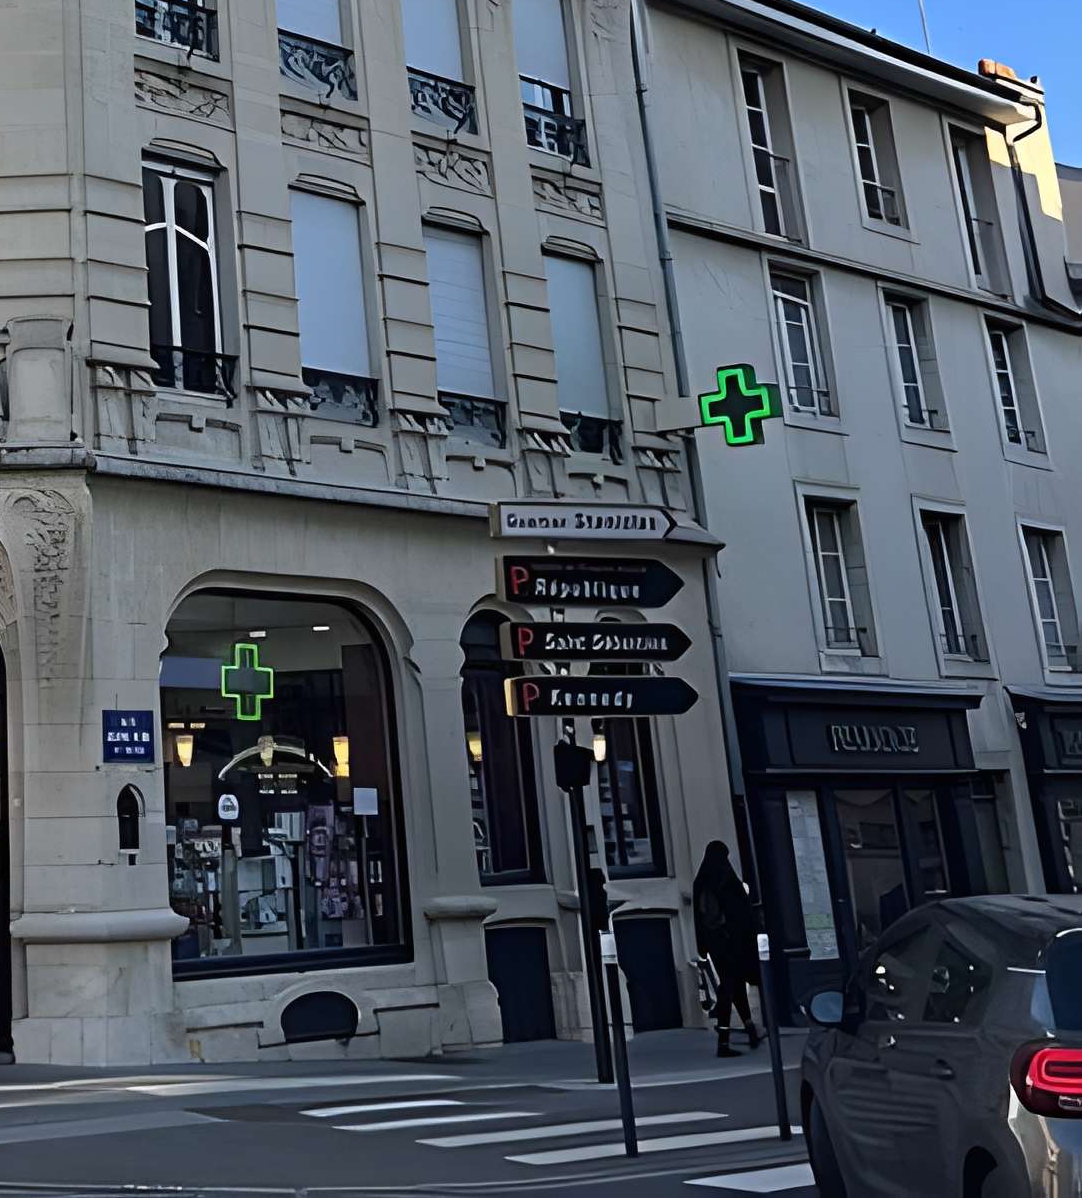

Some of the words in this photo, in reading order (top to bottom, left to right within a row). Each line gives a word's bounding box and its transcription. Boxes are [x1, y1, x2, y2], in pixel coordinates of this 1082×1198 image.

[511, 566, 529, 595] P
[518, 628, 534, 656] P
[523, 683, 539, 711] P
